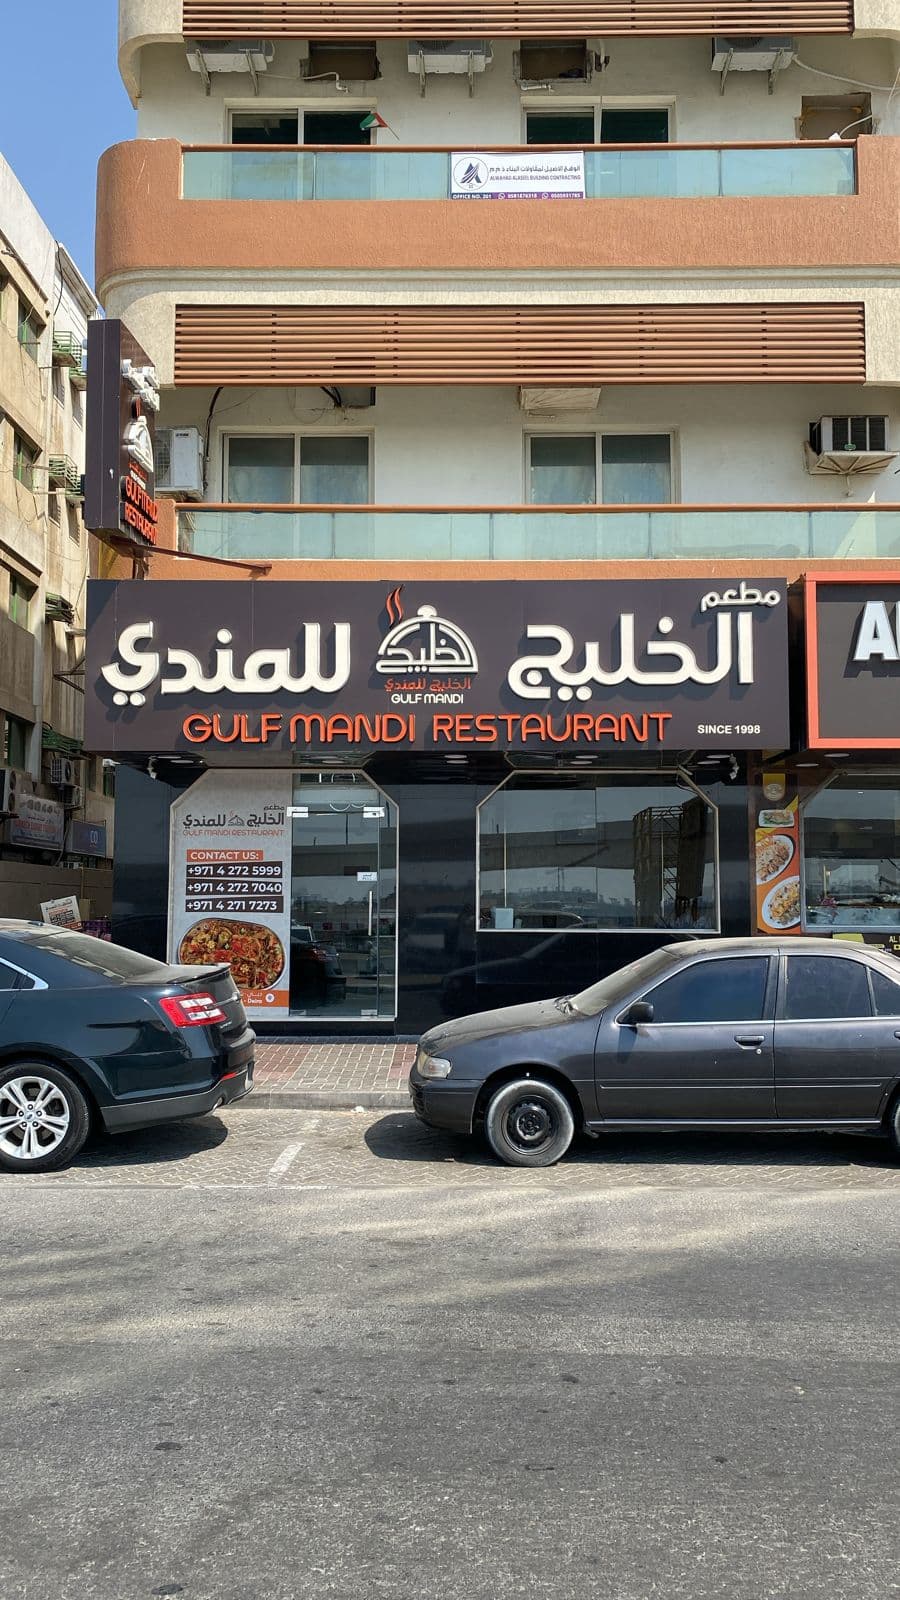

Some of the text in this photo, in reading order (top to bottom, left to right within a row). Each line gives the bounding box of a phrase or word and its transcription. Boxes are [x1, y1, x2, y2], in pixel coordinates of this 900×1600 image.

[520, 165, 544, 173] لمقاولات
[701, 581, 781, 612] مطعم
[101, 611, 754, 706] الخليج للمندي
[384, 677, 427, 693] للمندي
[391, 693, 464, 704] GULF MANDI
[182, 713, 673, 743] GULF MANDI RESTAURANT
[697, 724, 761, 735] SINCE 1998
[182, 814, 227, 830] للمندي
[246, 812, 285, 828] الخليج
[183, 829, 285, 837] GULF MANDI RESTAURANT
[190, 851, 259, 860] CONTACT US:
[188, 865, 281, 876] +971 4 272 5999
[187, 883, 282, 892] +971 4 272 7040
[187, 901, 277, 910] +971 4 271 7273
